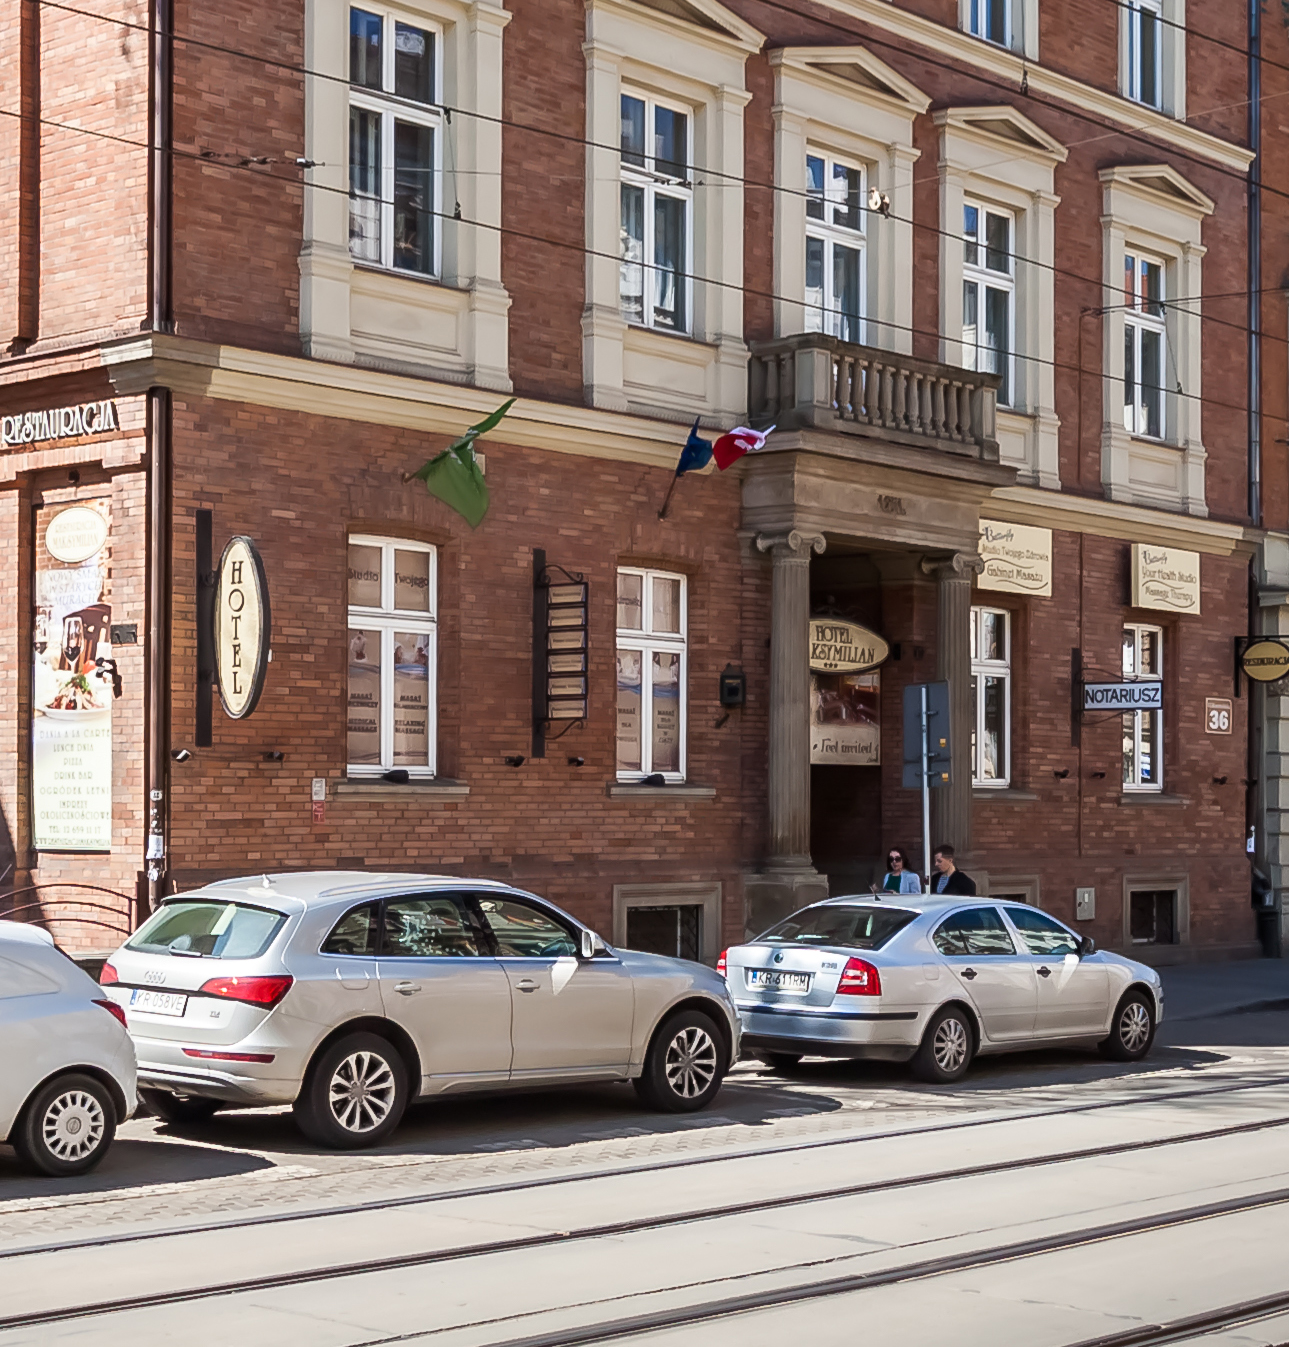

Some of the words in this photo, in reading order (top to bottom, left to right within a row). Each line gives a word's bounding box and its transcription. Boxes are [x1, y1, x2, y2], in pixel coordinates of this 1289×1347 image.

[1, 401, 116, 444] RESTAURACJA
[228, 561, 245, 695] HOTEL
[815, 625, 853, 644] HOTEL
[1085, 688, 1160, 704] NOTARIUSZ
[1209, 709, 1229, 730] 36
[758, 972, 773, 985] KR
[136, 992, 151, 1006] KR
[153, 993, 184, 1011] 058VE
